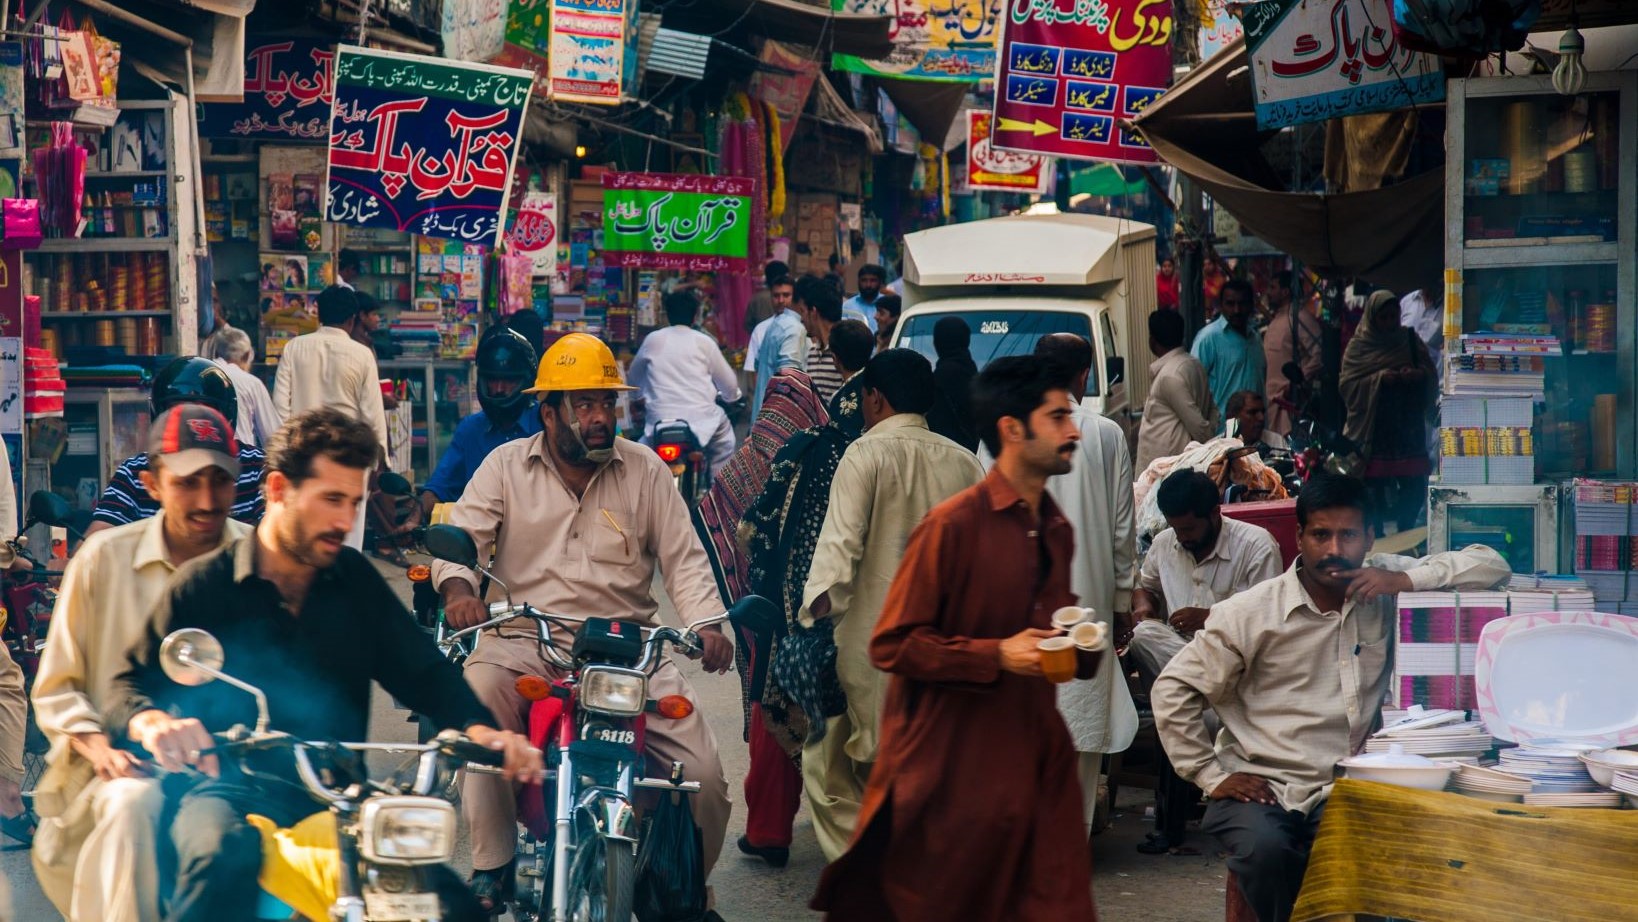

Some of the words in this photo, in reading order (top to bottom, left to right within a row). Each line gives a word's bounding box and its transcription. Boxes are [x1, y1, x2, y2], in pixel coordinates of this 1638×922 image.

[1272, 0, 1361, 85] پاک
[351, 61, 375, 87] پاک
[383, 65, 416, 88] کمپنی
[1085, 56, 1111, 76] شادی
[466, 74, 498, 101] کمپنی
[493, 76, 528, 106] تاج
[331, 97, 429, 199] پاک
[331, 190, 380, 223] شادی
[438, 213, 467, 237] بک
[613, 192, 674, 252] پاک
[670, 197, 742, 245] قرآن
[600, 729, 635, 744] 8118
